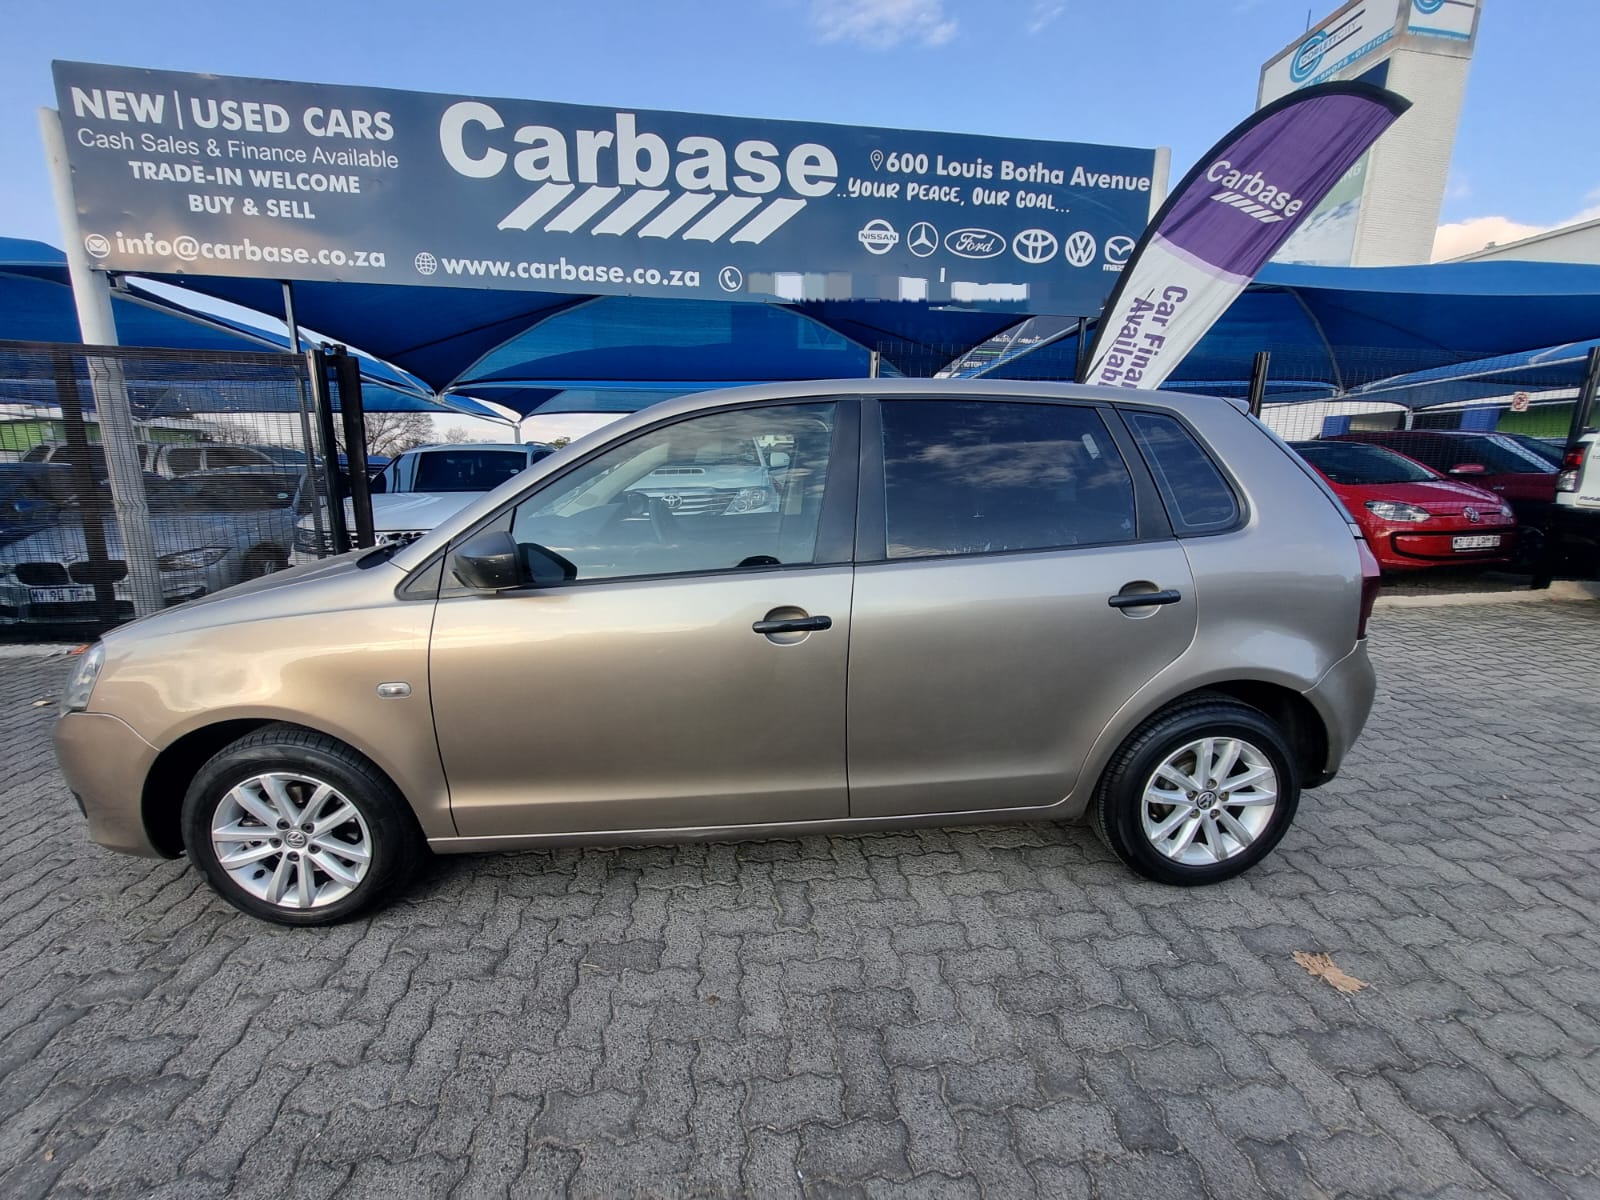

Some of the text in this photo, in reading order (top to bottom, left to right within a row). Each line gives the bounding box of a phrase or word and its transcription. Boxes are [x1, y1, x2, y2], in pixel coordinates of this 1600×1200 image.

[71, 86, 394, 141] NEW USED CARS
[77, 128, 399, 169] Cash Sales & Finance Available
[439, 101, 838, 197] Carbase
[128, 160, 361, 194] TRADE-IN WELCOME
[886, 152, 1150, 192] 600 Louis Botha Avenue
[1207, 160, 1303, 218] Carbase
[189, 194, 315, 219] BUY & SELL
[907, 182, 964, 206] PEACE,
[972, 187, 1010, 206] OUR
[116, 232, 386, 268] info@carbase.co.za
[860, 232, 897, 241] NISSAN
[955, 234, 994, 253] Ford
[442, 257, 700, 287] www.carbase.co.za
[1152, 286, 1188, 327] Car
